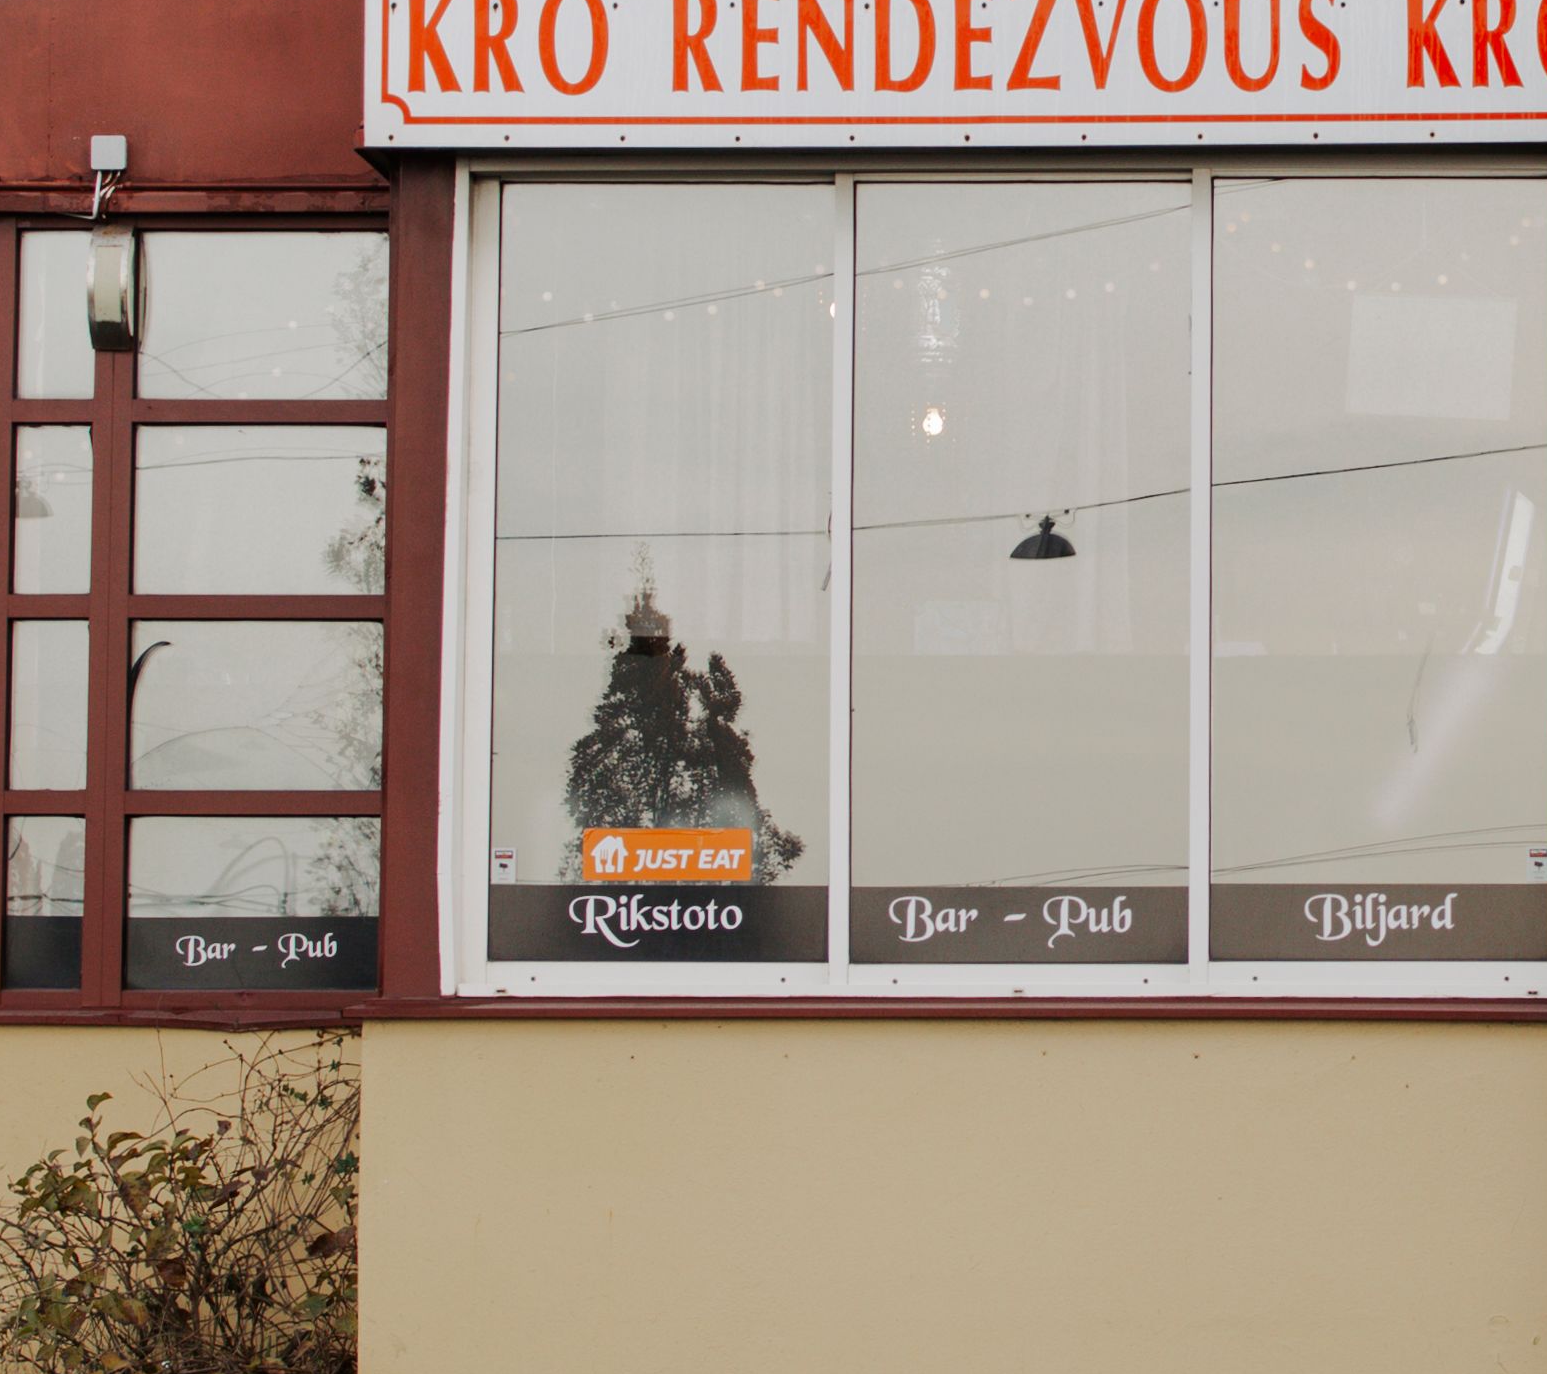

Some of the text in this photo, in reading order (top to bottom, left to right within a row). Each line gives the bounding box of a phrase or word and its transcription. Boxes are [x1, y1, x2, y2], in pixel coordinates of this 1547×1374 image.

[632, 848, 746, 872] JUST EAT
[568, 893, 743, 948] Rikstoto
[888, 895, 979, 943] Bar
[1042, 895, 1133, 949] Pub
[1304, 892, 1458, 947] Biljard
[175, 935, 236, 967] Bar
[277, 932, 338, 969] Pub
